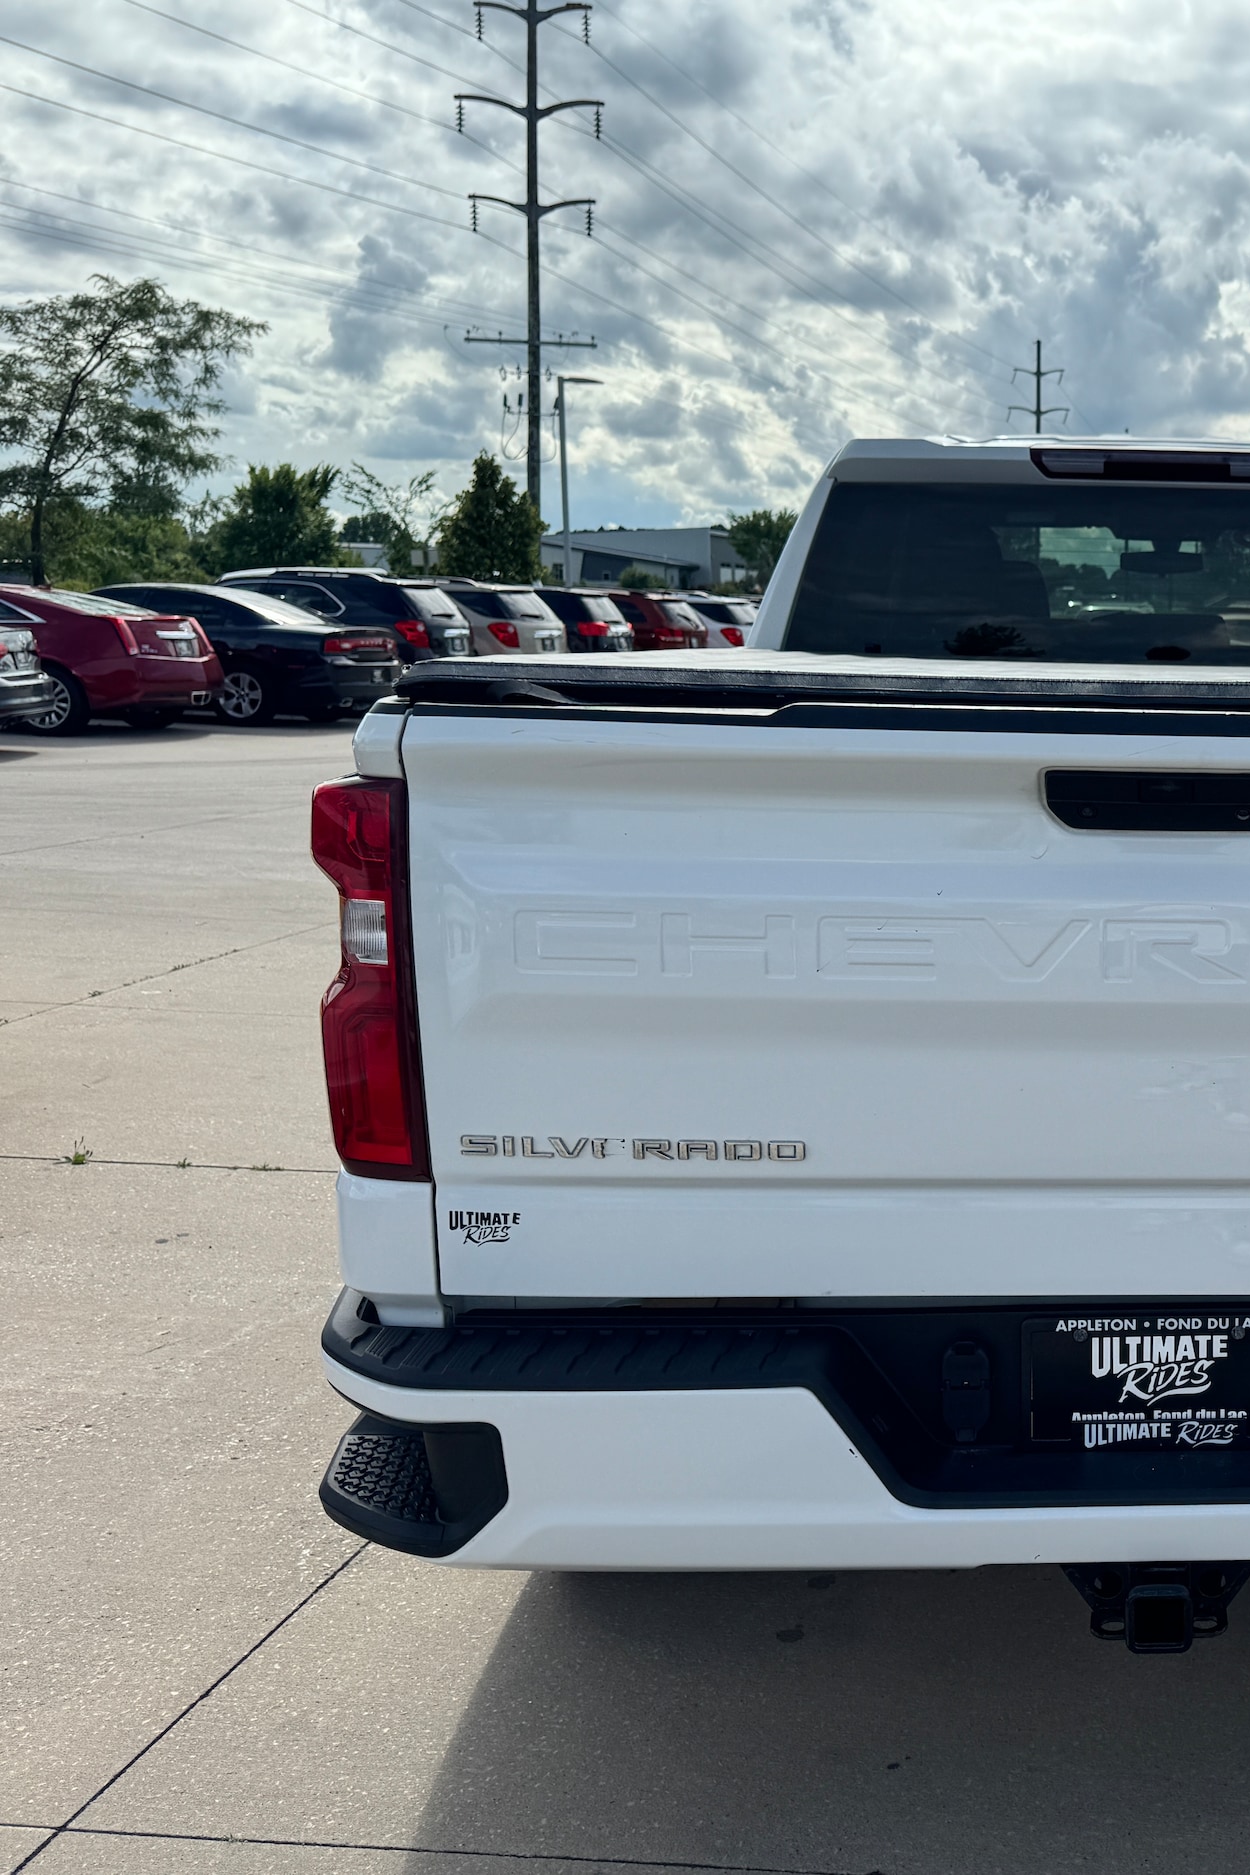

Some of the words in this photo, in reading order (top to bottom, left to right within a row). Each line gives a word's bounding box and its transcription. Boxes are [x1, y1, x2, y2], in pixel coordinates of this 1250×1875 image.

[449, 1210, 521, 1231] ULTIMATE
[1055, 1318, 1137, 1332] APPLETON
[1157, 1318, 1202, 1331] FOND
[1207, 1317, 1230, 1330] DU
[1091, 1334, 1228, 1378] ULTIMATE
[1084, 1422, 1172, 1448] ULTIMATE
